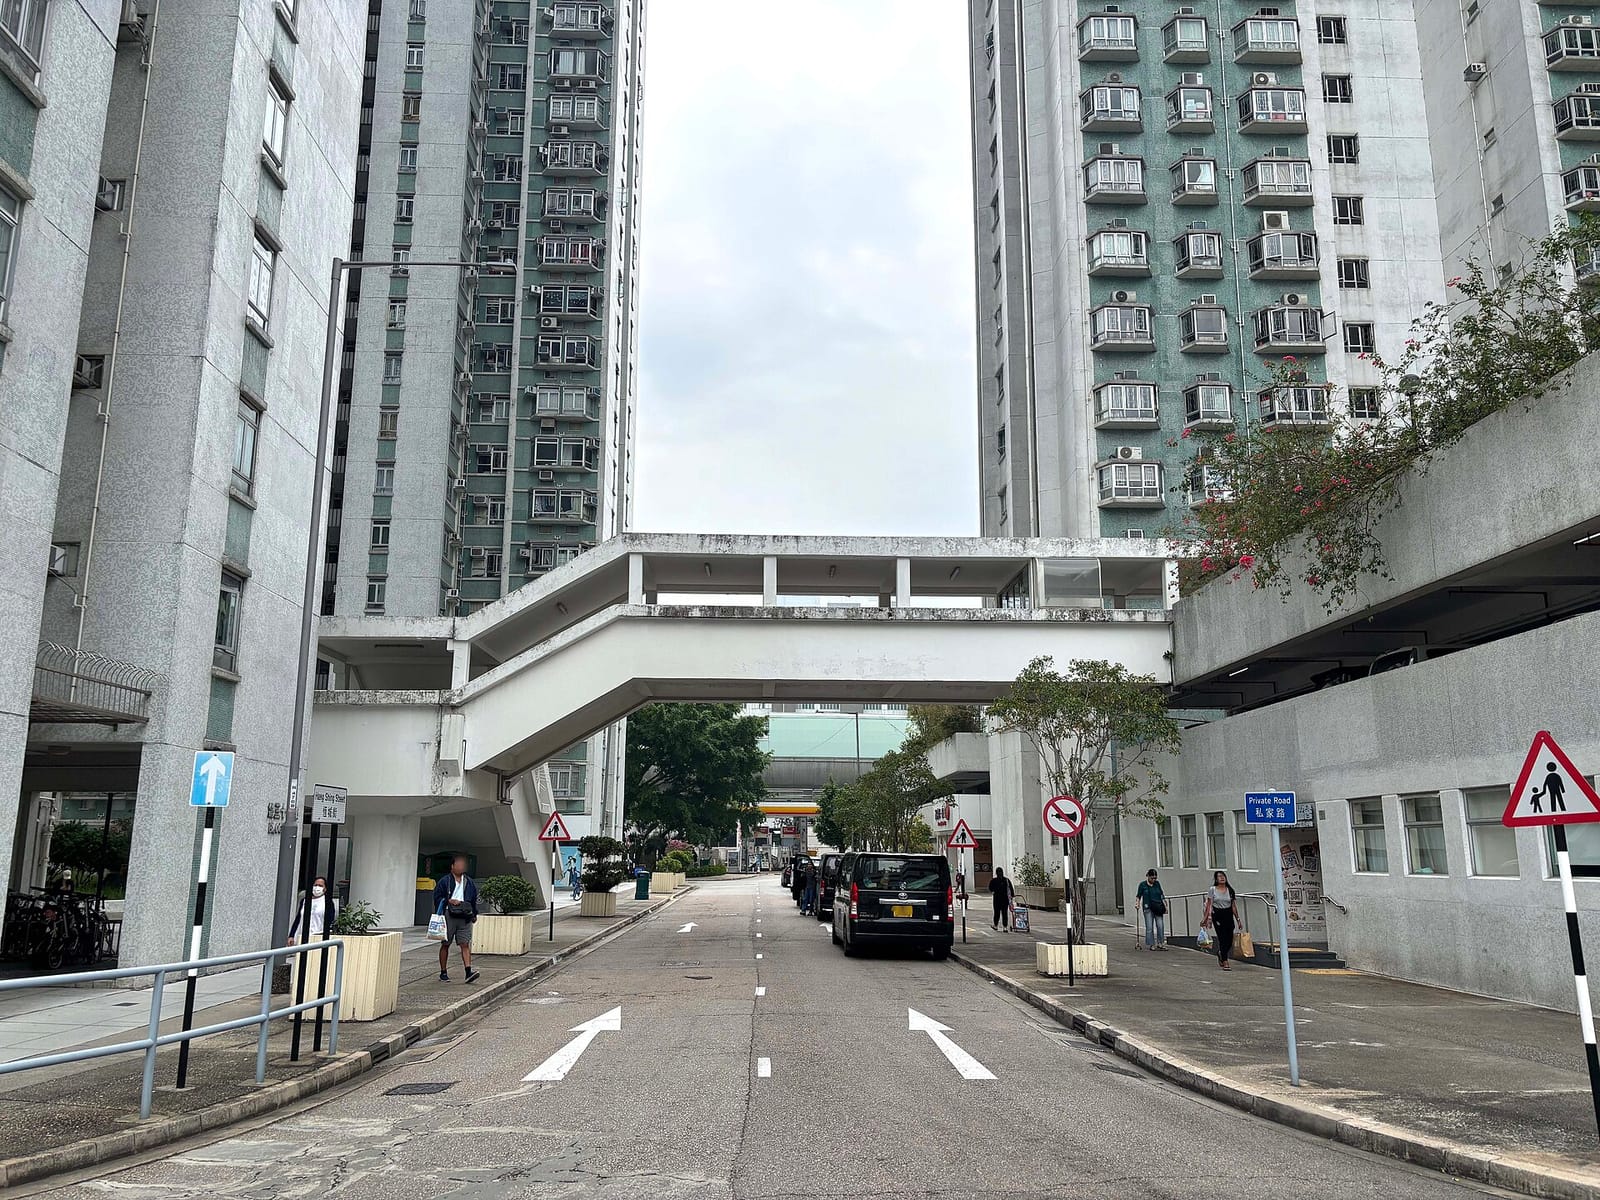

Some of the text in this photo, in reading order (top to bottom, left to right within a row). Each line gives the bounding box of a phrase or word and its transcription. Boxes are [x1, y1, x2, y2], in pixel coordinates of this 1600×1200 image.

[1248, 797, 1290, 805] Private Road
[1255, 807, 1285, 818] 私家路
